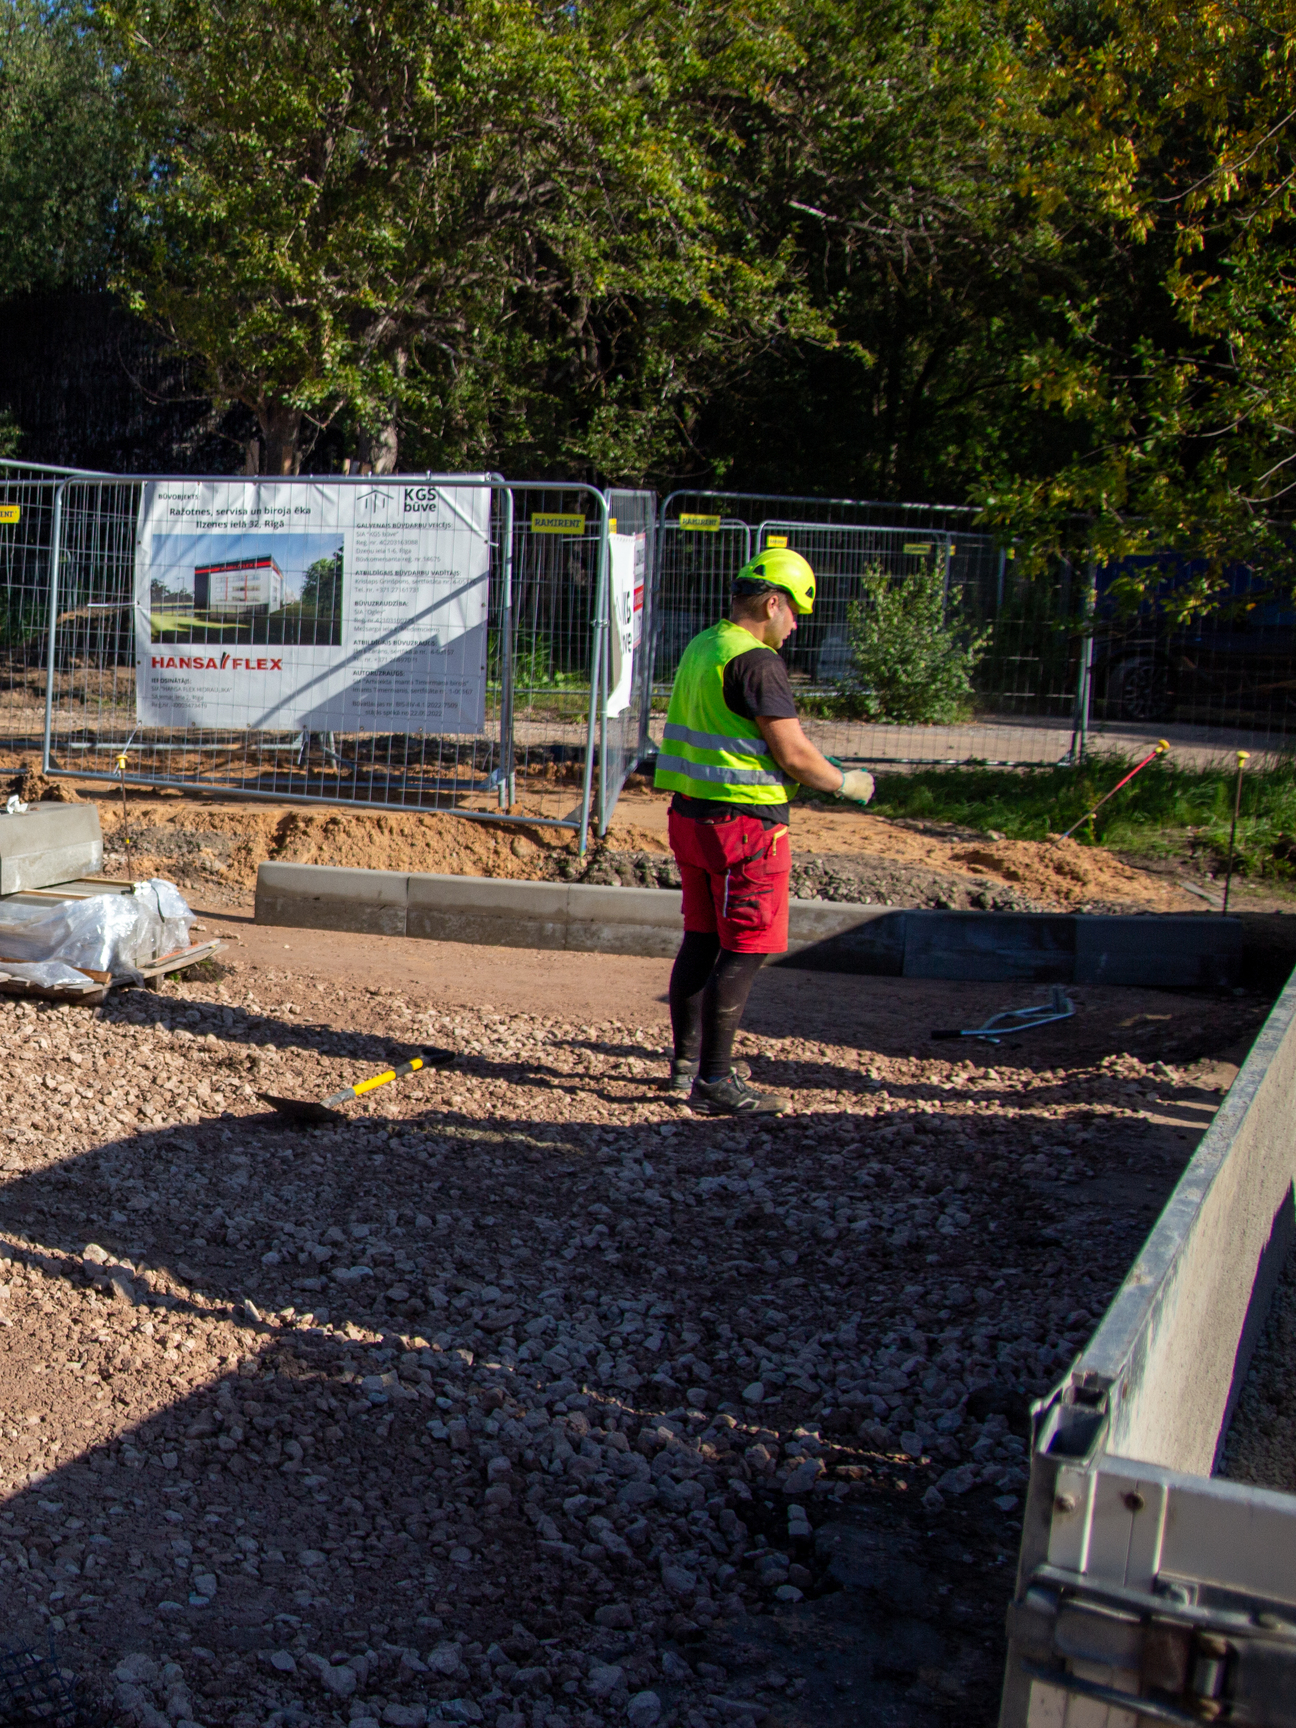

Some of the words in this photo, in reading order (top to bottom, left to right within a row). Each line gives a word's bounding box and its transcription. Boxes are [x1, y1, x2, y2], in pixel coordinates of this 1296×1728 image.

[404, 488, 437, 501] KGS
[169, 507, 214, 517] Ražotnes,
[216, 508, 247, 516] servisa
[264, 506, 292, 517] biroja
[294, 506, 312, 515] ēka
[404, 501, 437, 513] būve
[196, 520, 228, 529] Ilzenes
[230, 519, 247, 528] ielā
[248, 520, 262, 529] 32,
[264, 519, 285, 530] Rīgā
[534, 518, 582, 528] RAMIRENT
[151, 656, 218, 669] HANSA
[232, 658, 283, 670] FLEX
